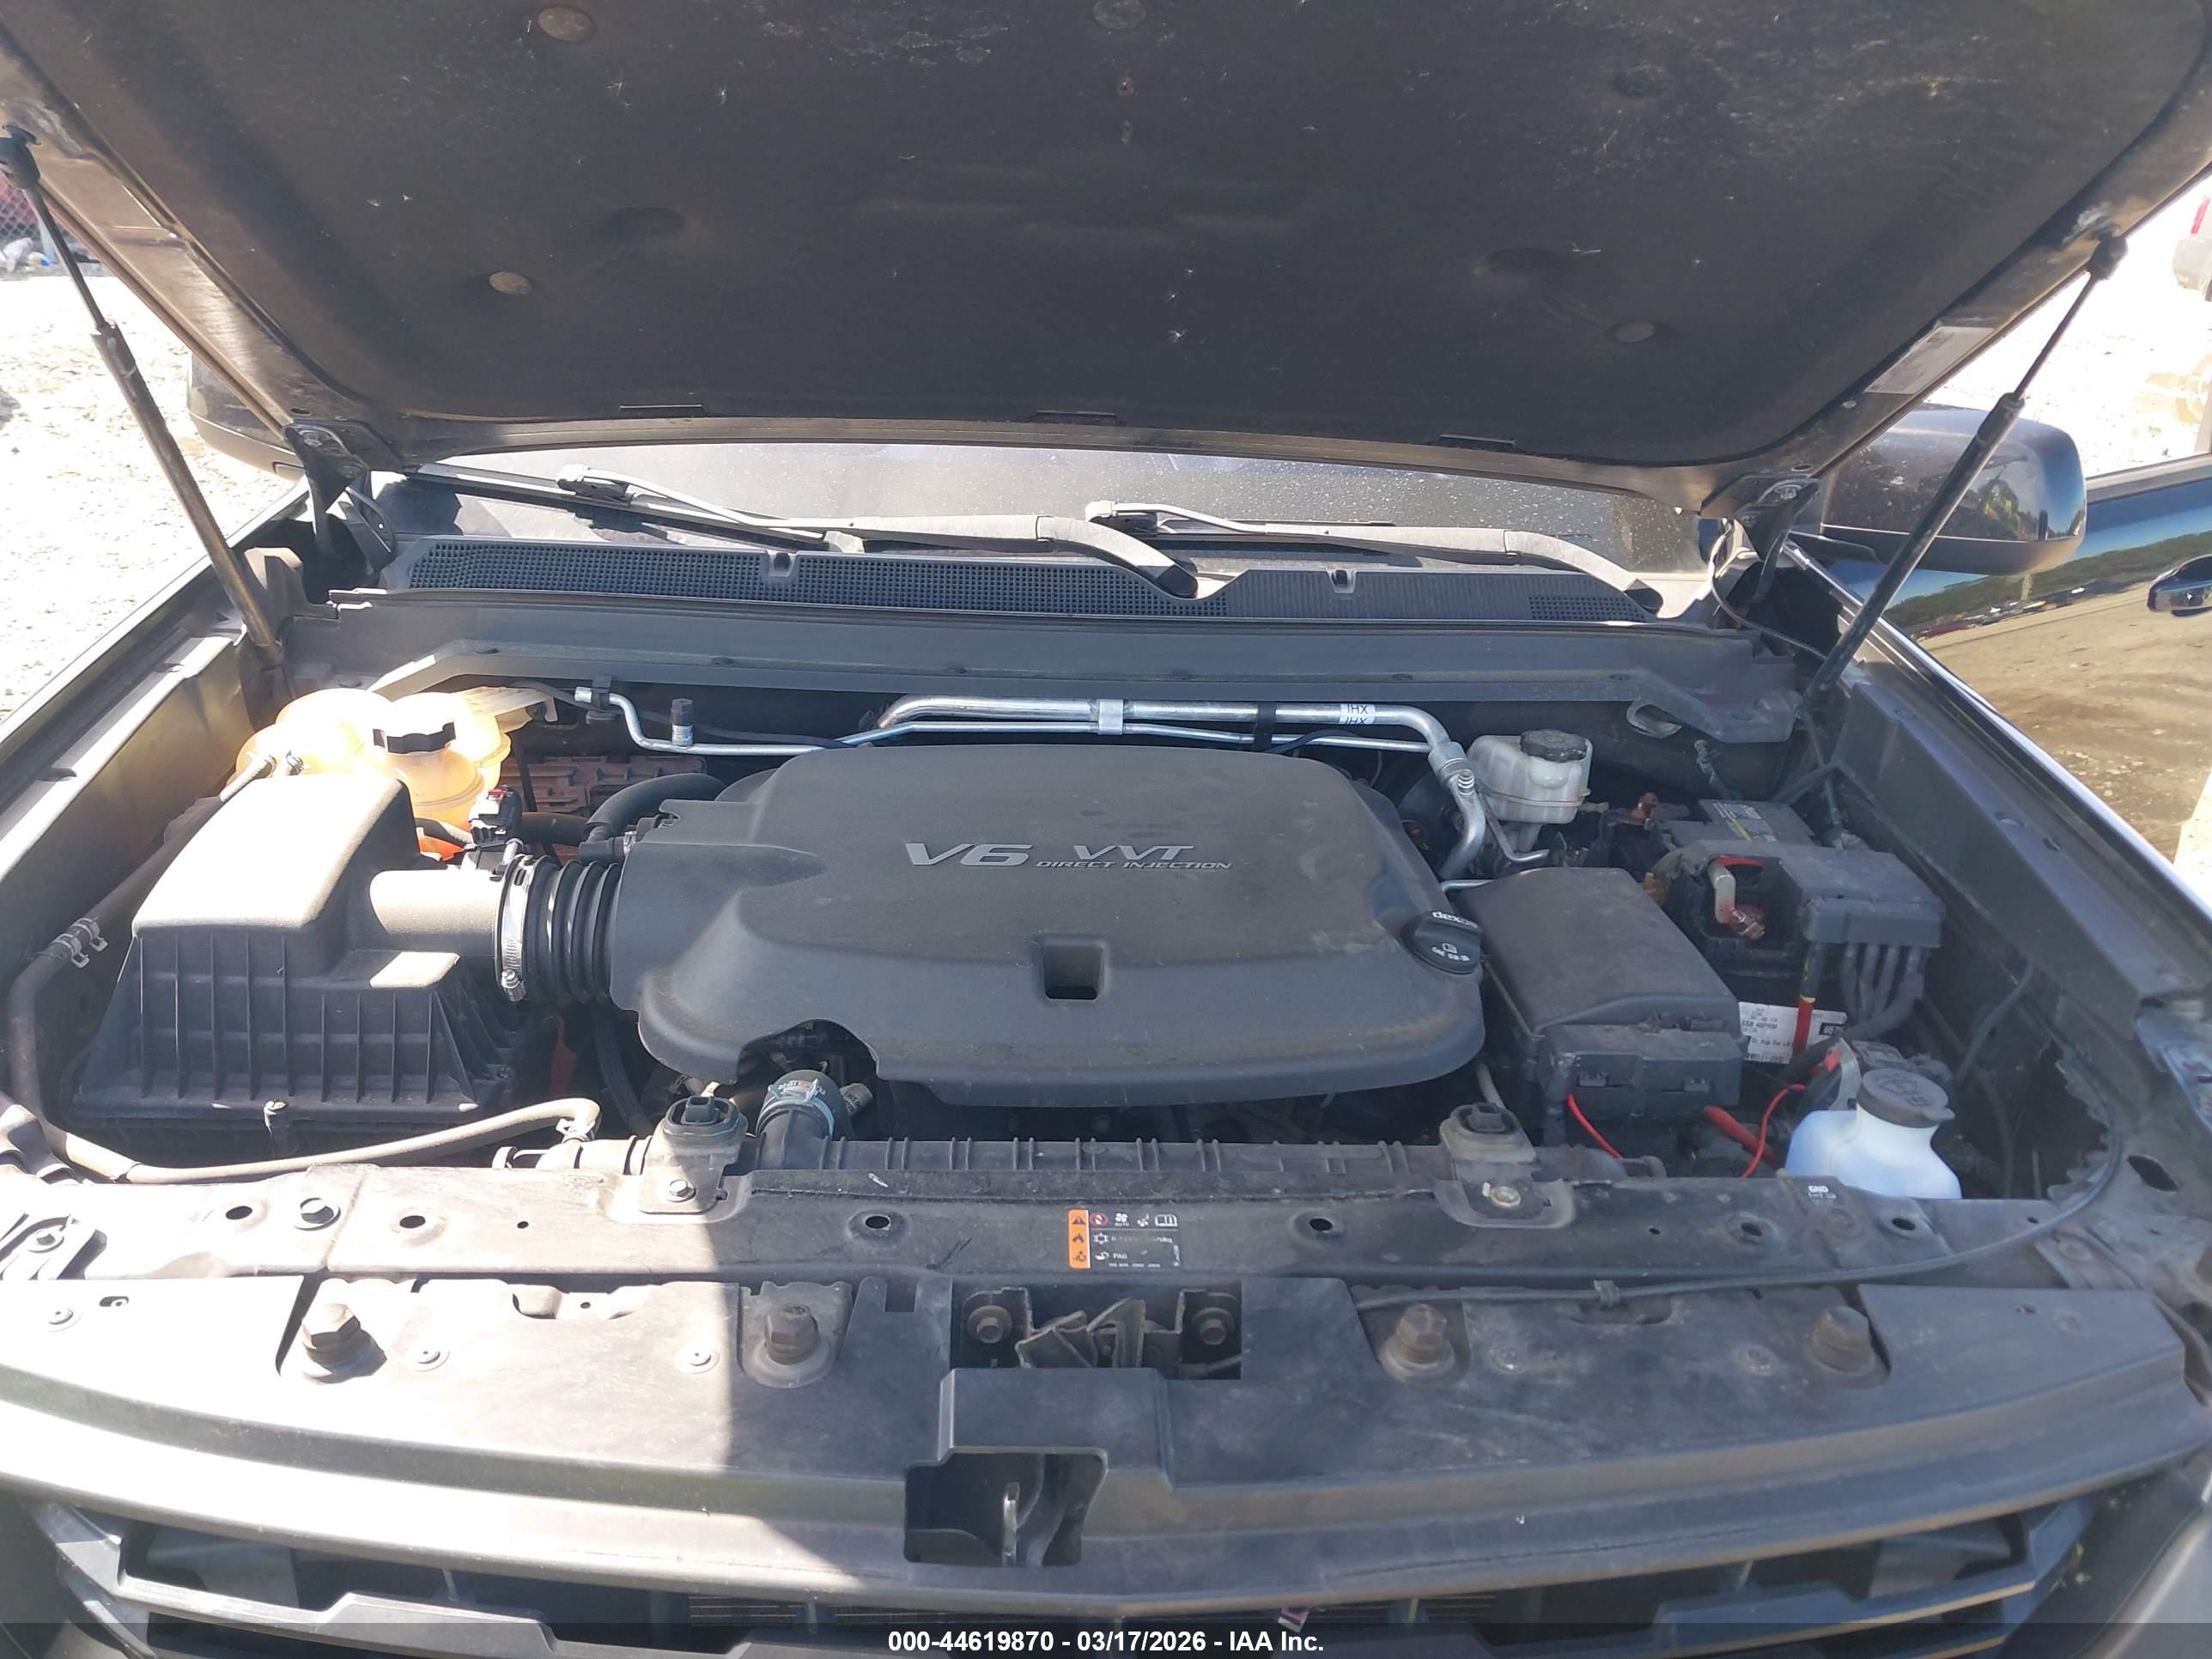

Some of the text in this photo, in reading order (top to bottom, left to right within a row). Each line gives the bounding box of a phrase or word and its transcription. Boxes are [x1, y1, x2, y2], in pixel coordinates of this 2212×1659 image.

[905, 842, 1195, 866] V6 VVT
[1121, 861, 1232, 870] INJECTION
